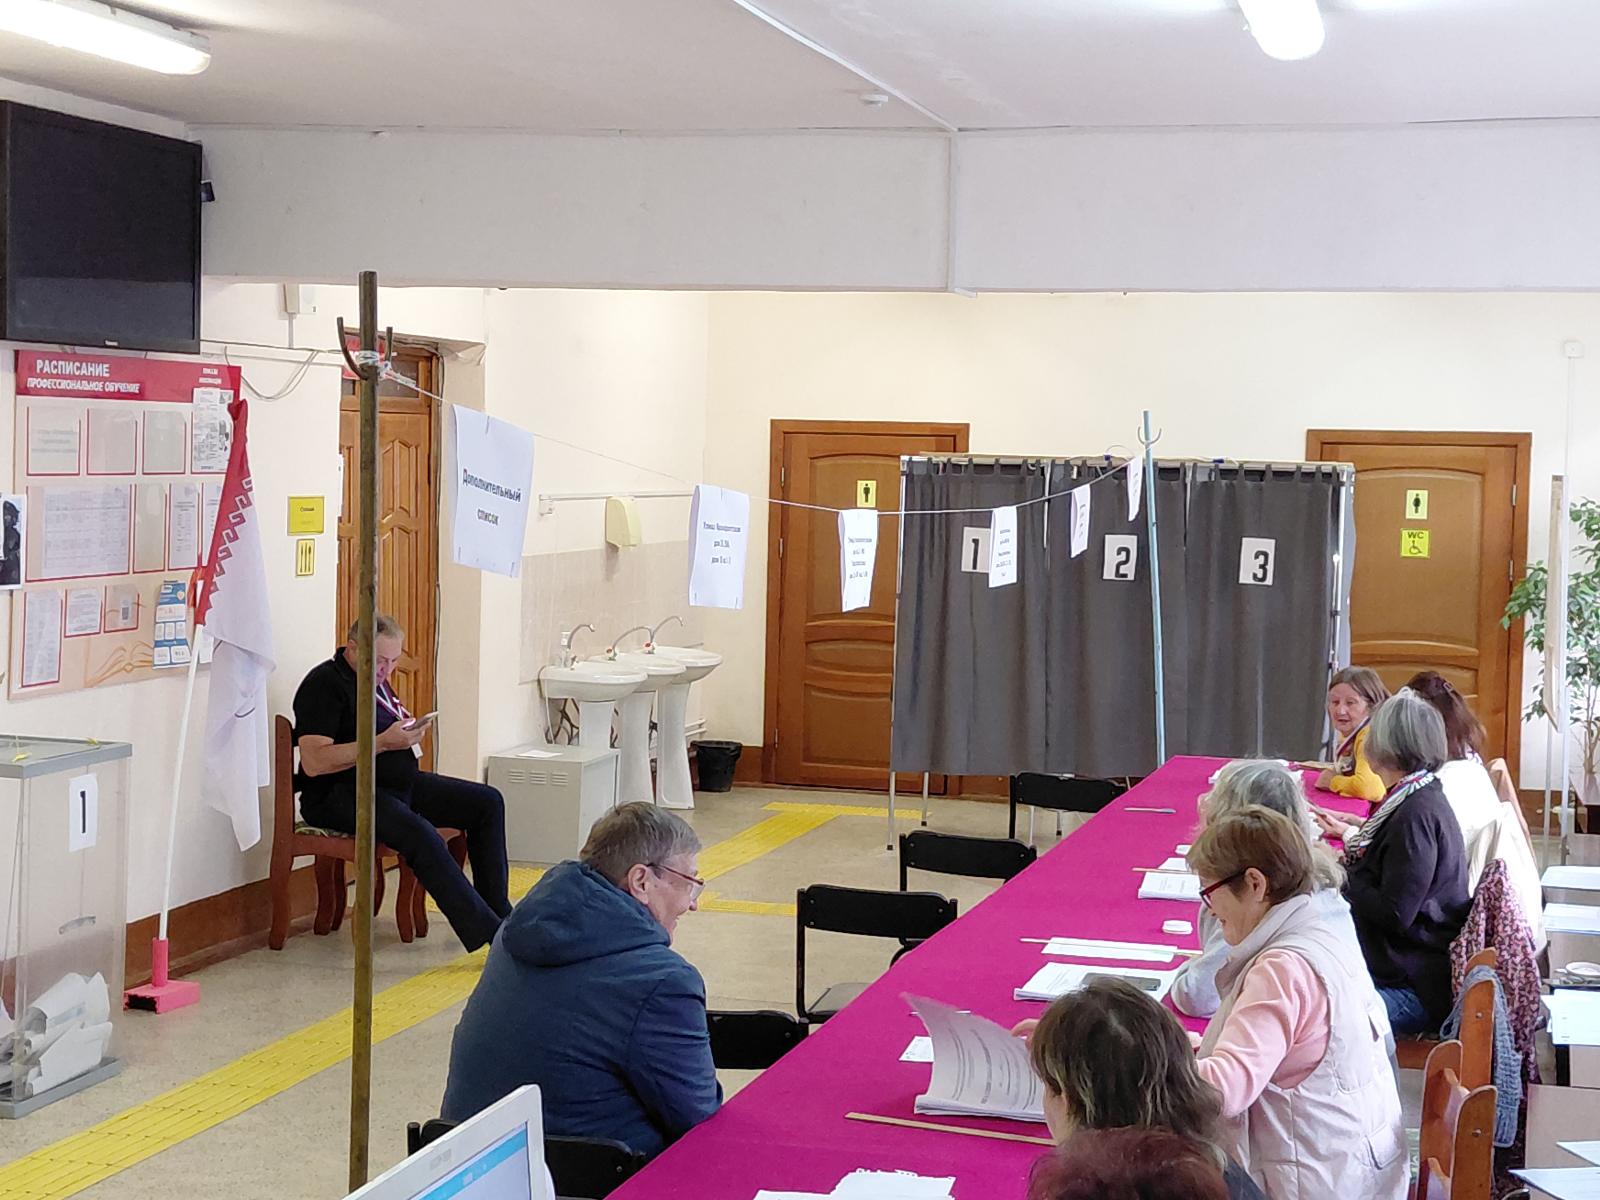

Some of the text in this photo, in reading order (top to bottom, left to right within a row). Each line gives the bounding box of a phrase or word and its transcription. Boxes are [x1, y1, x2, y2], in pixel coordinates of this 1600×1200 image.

[36, 359, 111, 378] РАСПИСАНИЕ
[26, 377, 141, 394] ПРОФЕССИОНАЛЬНОЕ ОБУЧЕНИЕ
[462, 469, 521, 503] Дополнительный
[476, 508, 499, 526] список
[1407, 531, 1424, 540] WC
[972, 538, 980, 571] 1
[1114, 546, 1131, 579] 2
[1252, 550, 1269, 583] 3
[80, 790, 86, 834] 1
